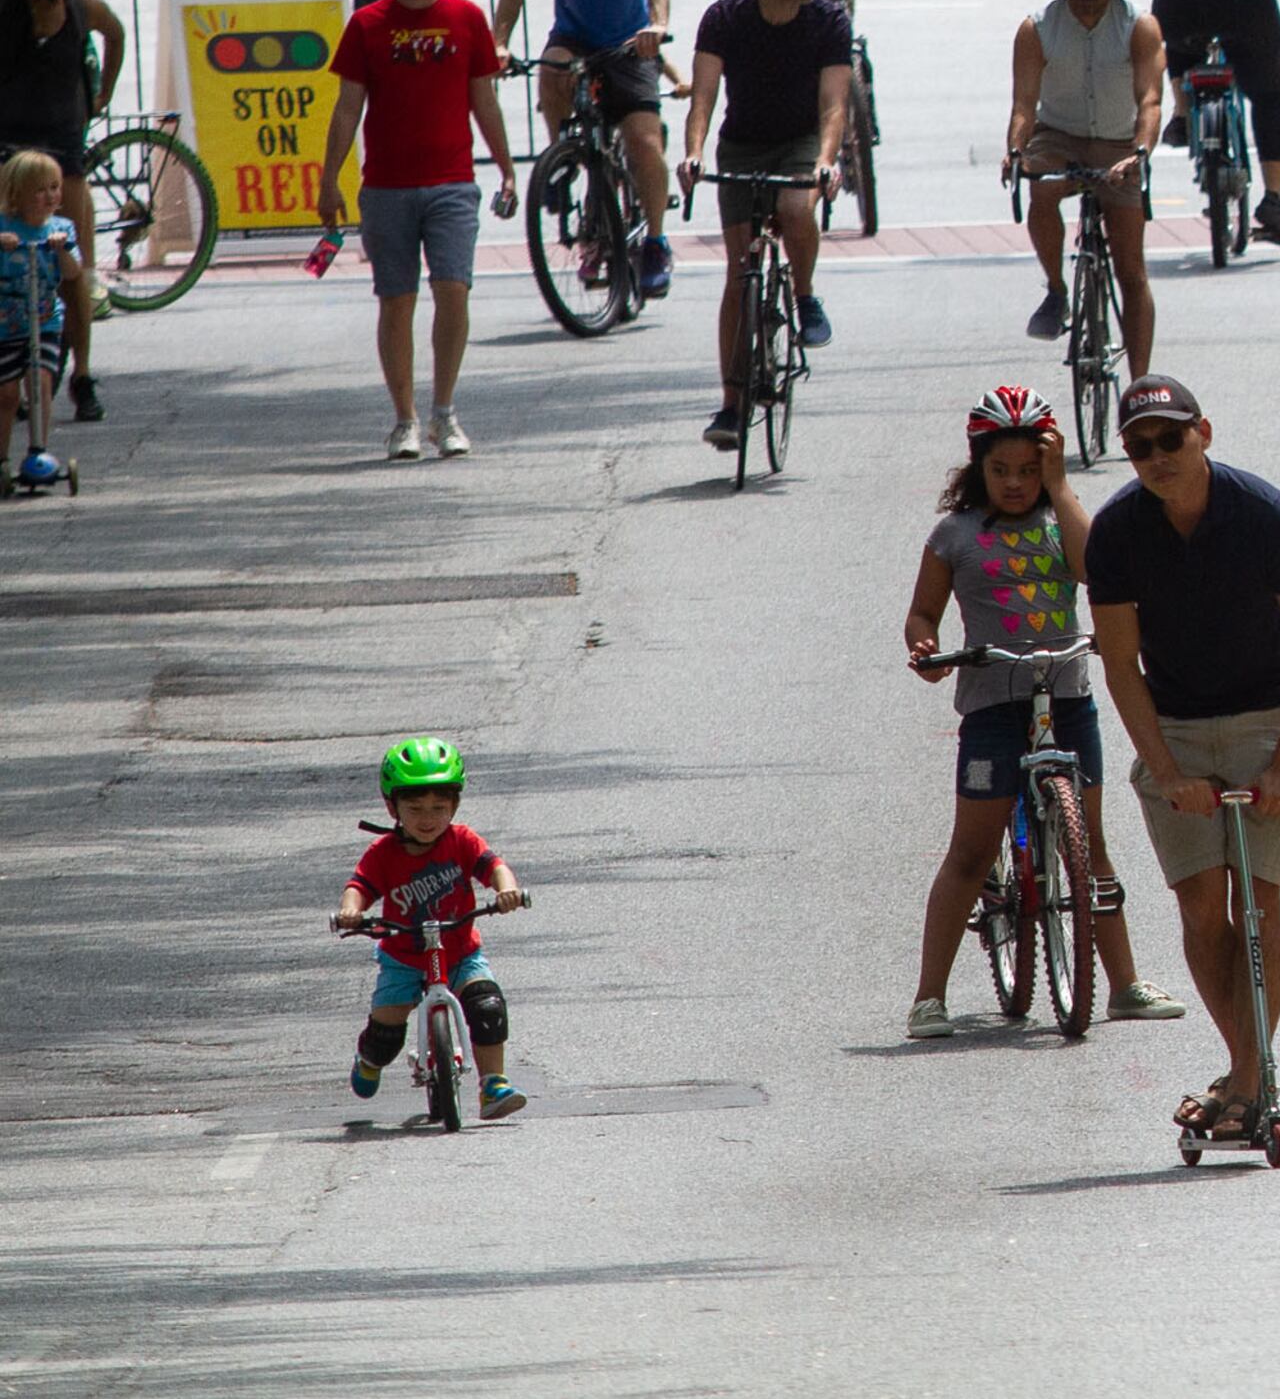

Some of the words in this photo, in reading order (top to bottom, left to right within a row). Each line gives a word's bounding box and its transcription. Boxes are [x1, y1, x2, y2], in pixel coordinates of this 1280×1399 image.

[232, 86, 316, 121] STOP
[257, 123, 299, 157] ON
[1129, 390, 1172, 411] BOND
[390, 865, 464, 917] SPIDER-MAN
